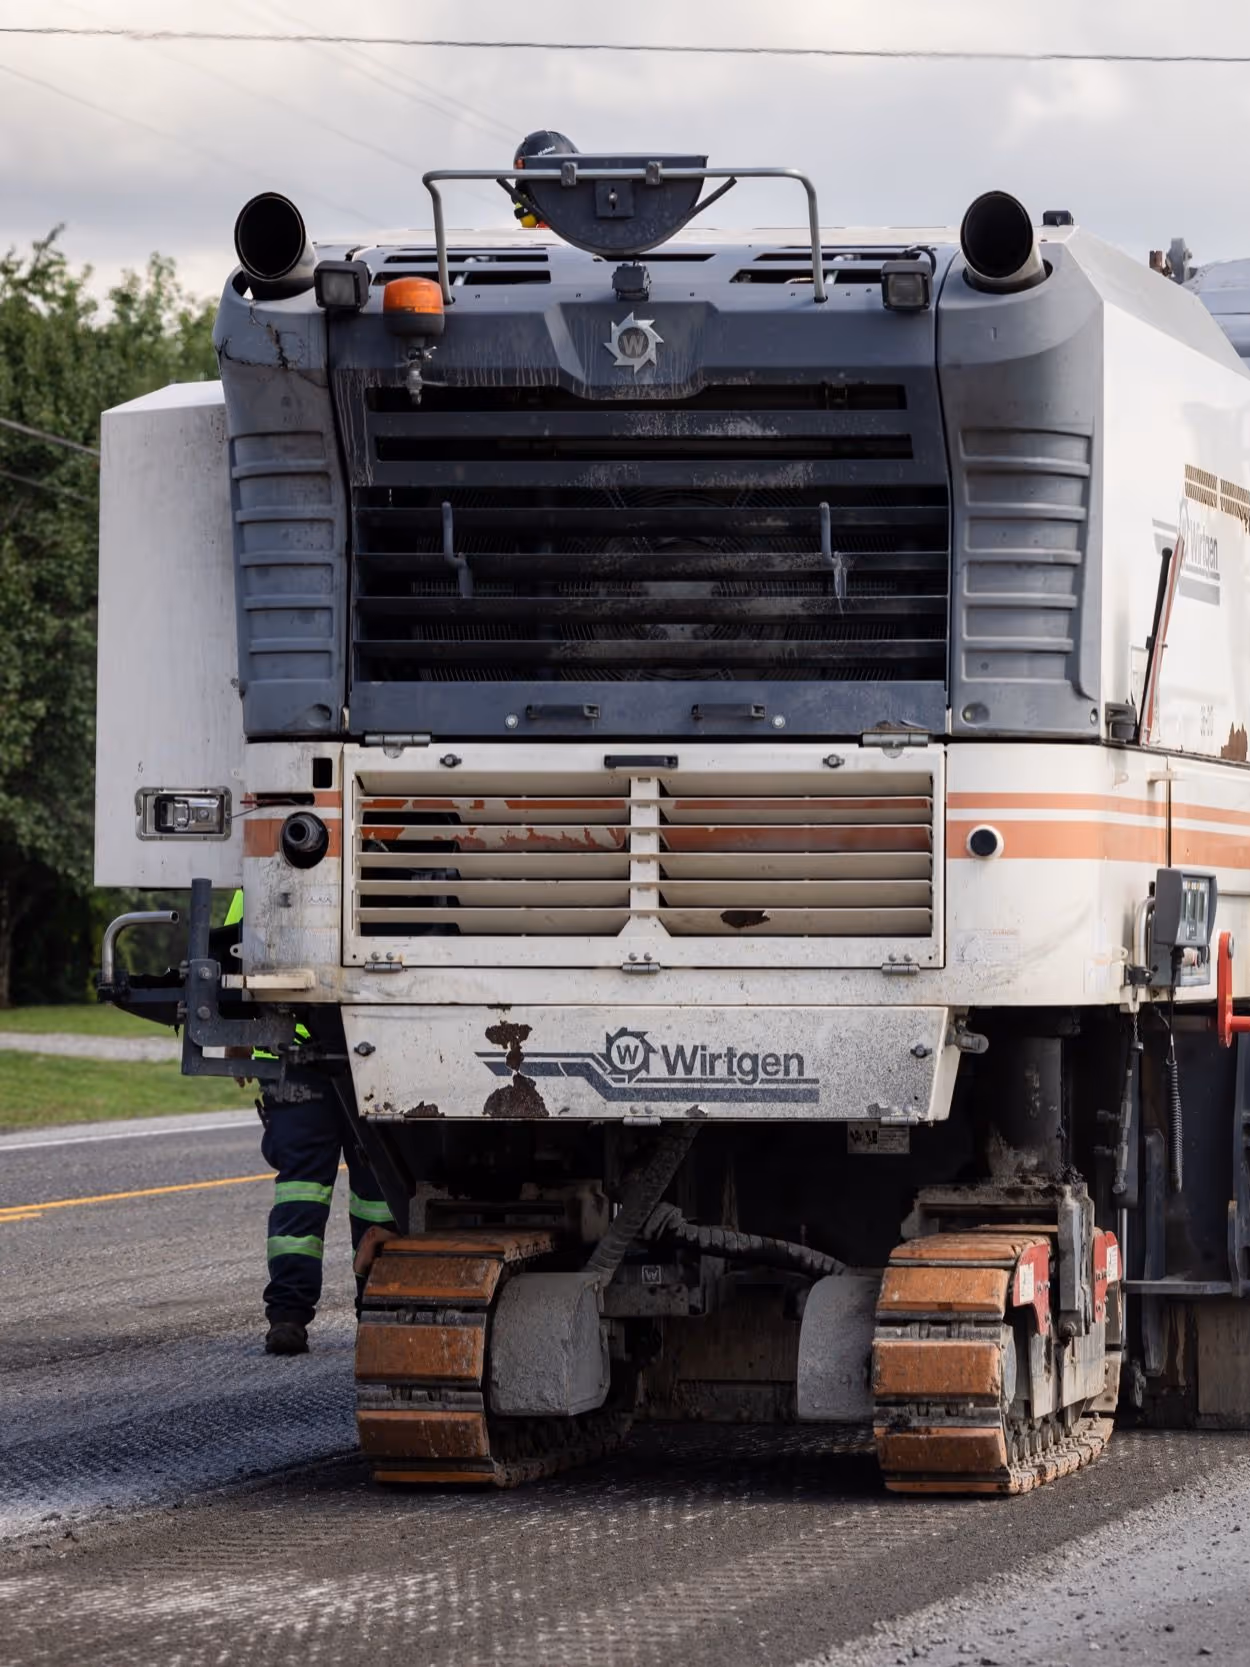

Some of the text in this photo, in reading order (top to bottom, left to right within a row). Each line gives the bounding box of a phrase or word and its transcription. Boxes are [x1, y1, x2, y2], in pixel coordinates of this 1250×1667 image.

[622, 335, 645, 356] W
[616, 1044, 805, 1086] W Wirtgen
